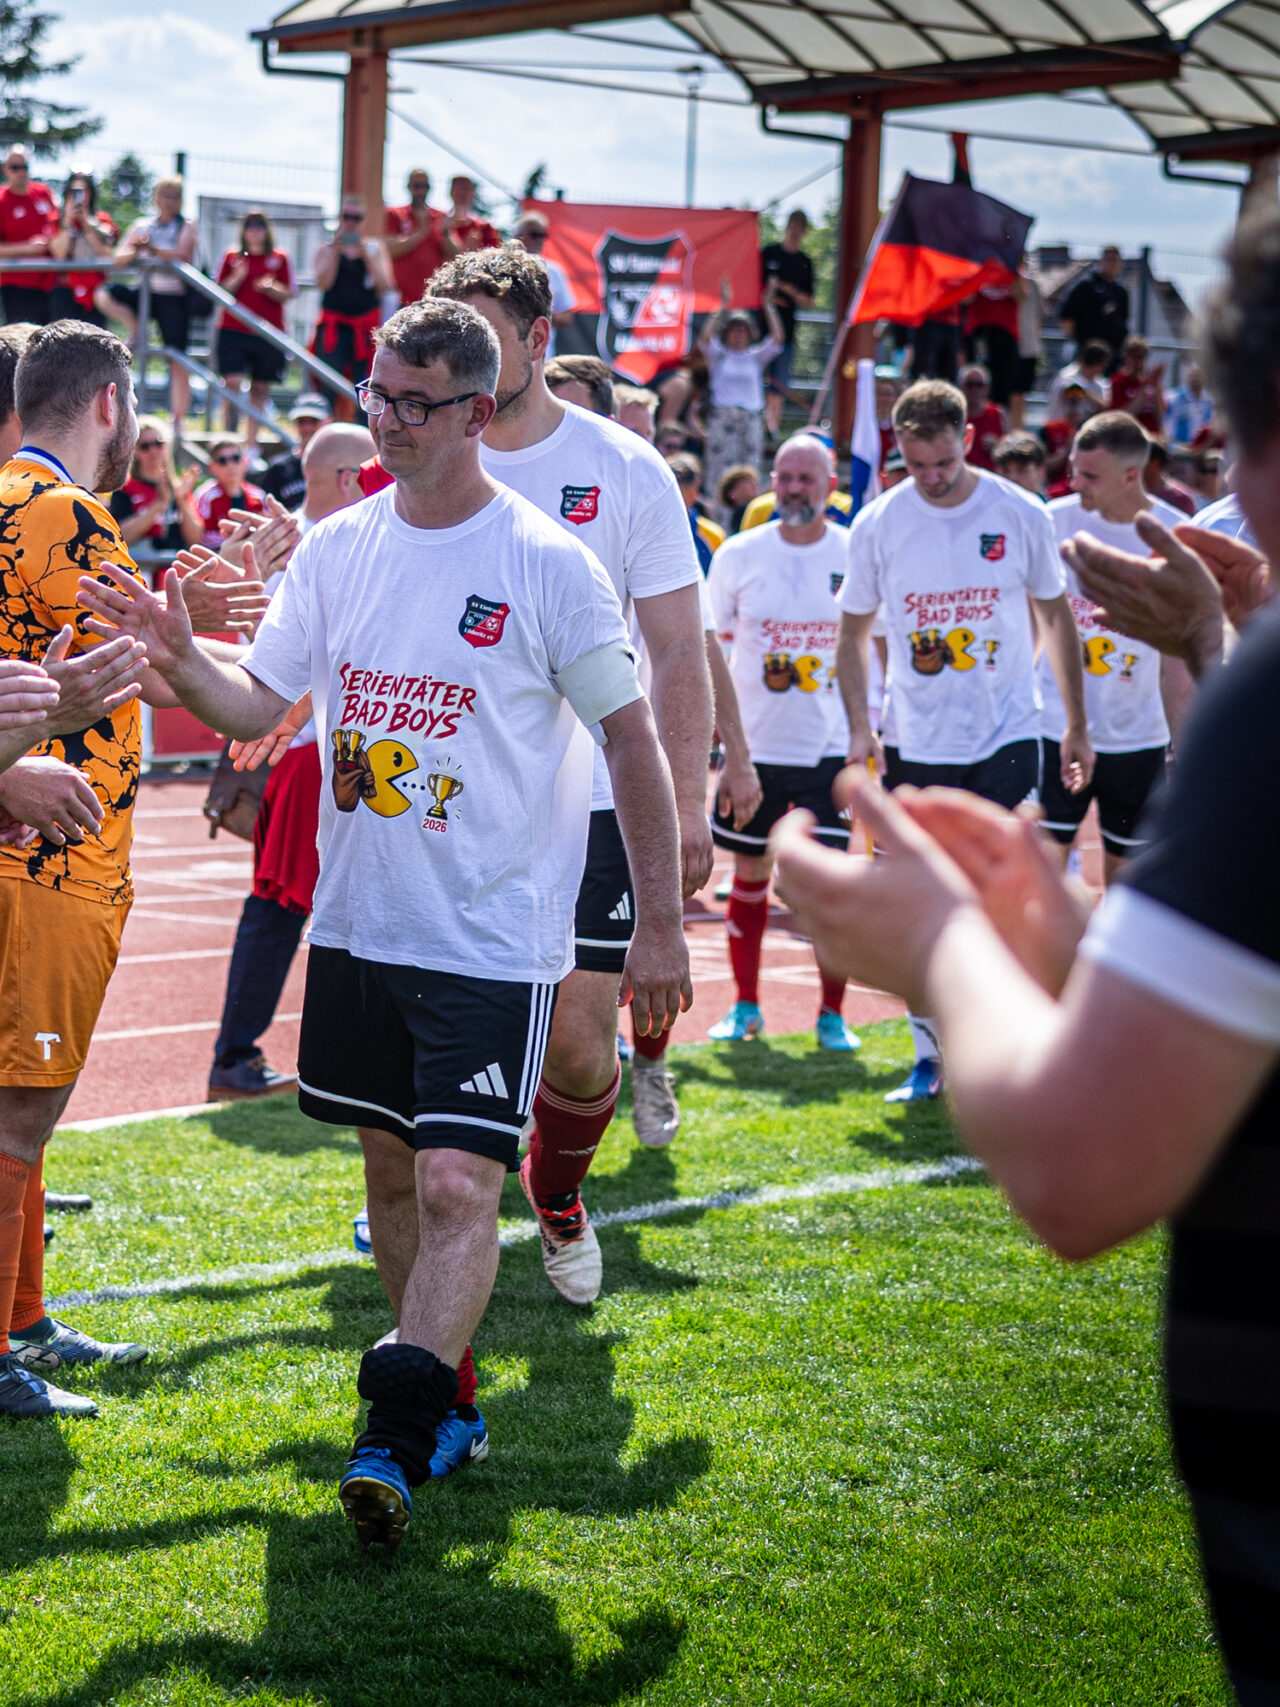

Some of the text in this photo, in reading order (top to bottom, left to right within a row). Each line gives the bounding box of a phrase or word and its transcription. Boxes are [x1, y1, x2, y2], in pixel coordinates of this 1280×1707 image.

[917, 604, 995, 628] BAD BOYS
[339, 662, 477, 716] SERIENTÄTER
[339, 694, 463, 740] BAD BOYS
[422, 818, 448, 833] 2026
